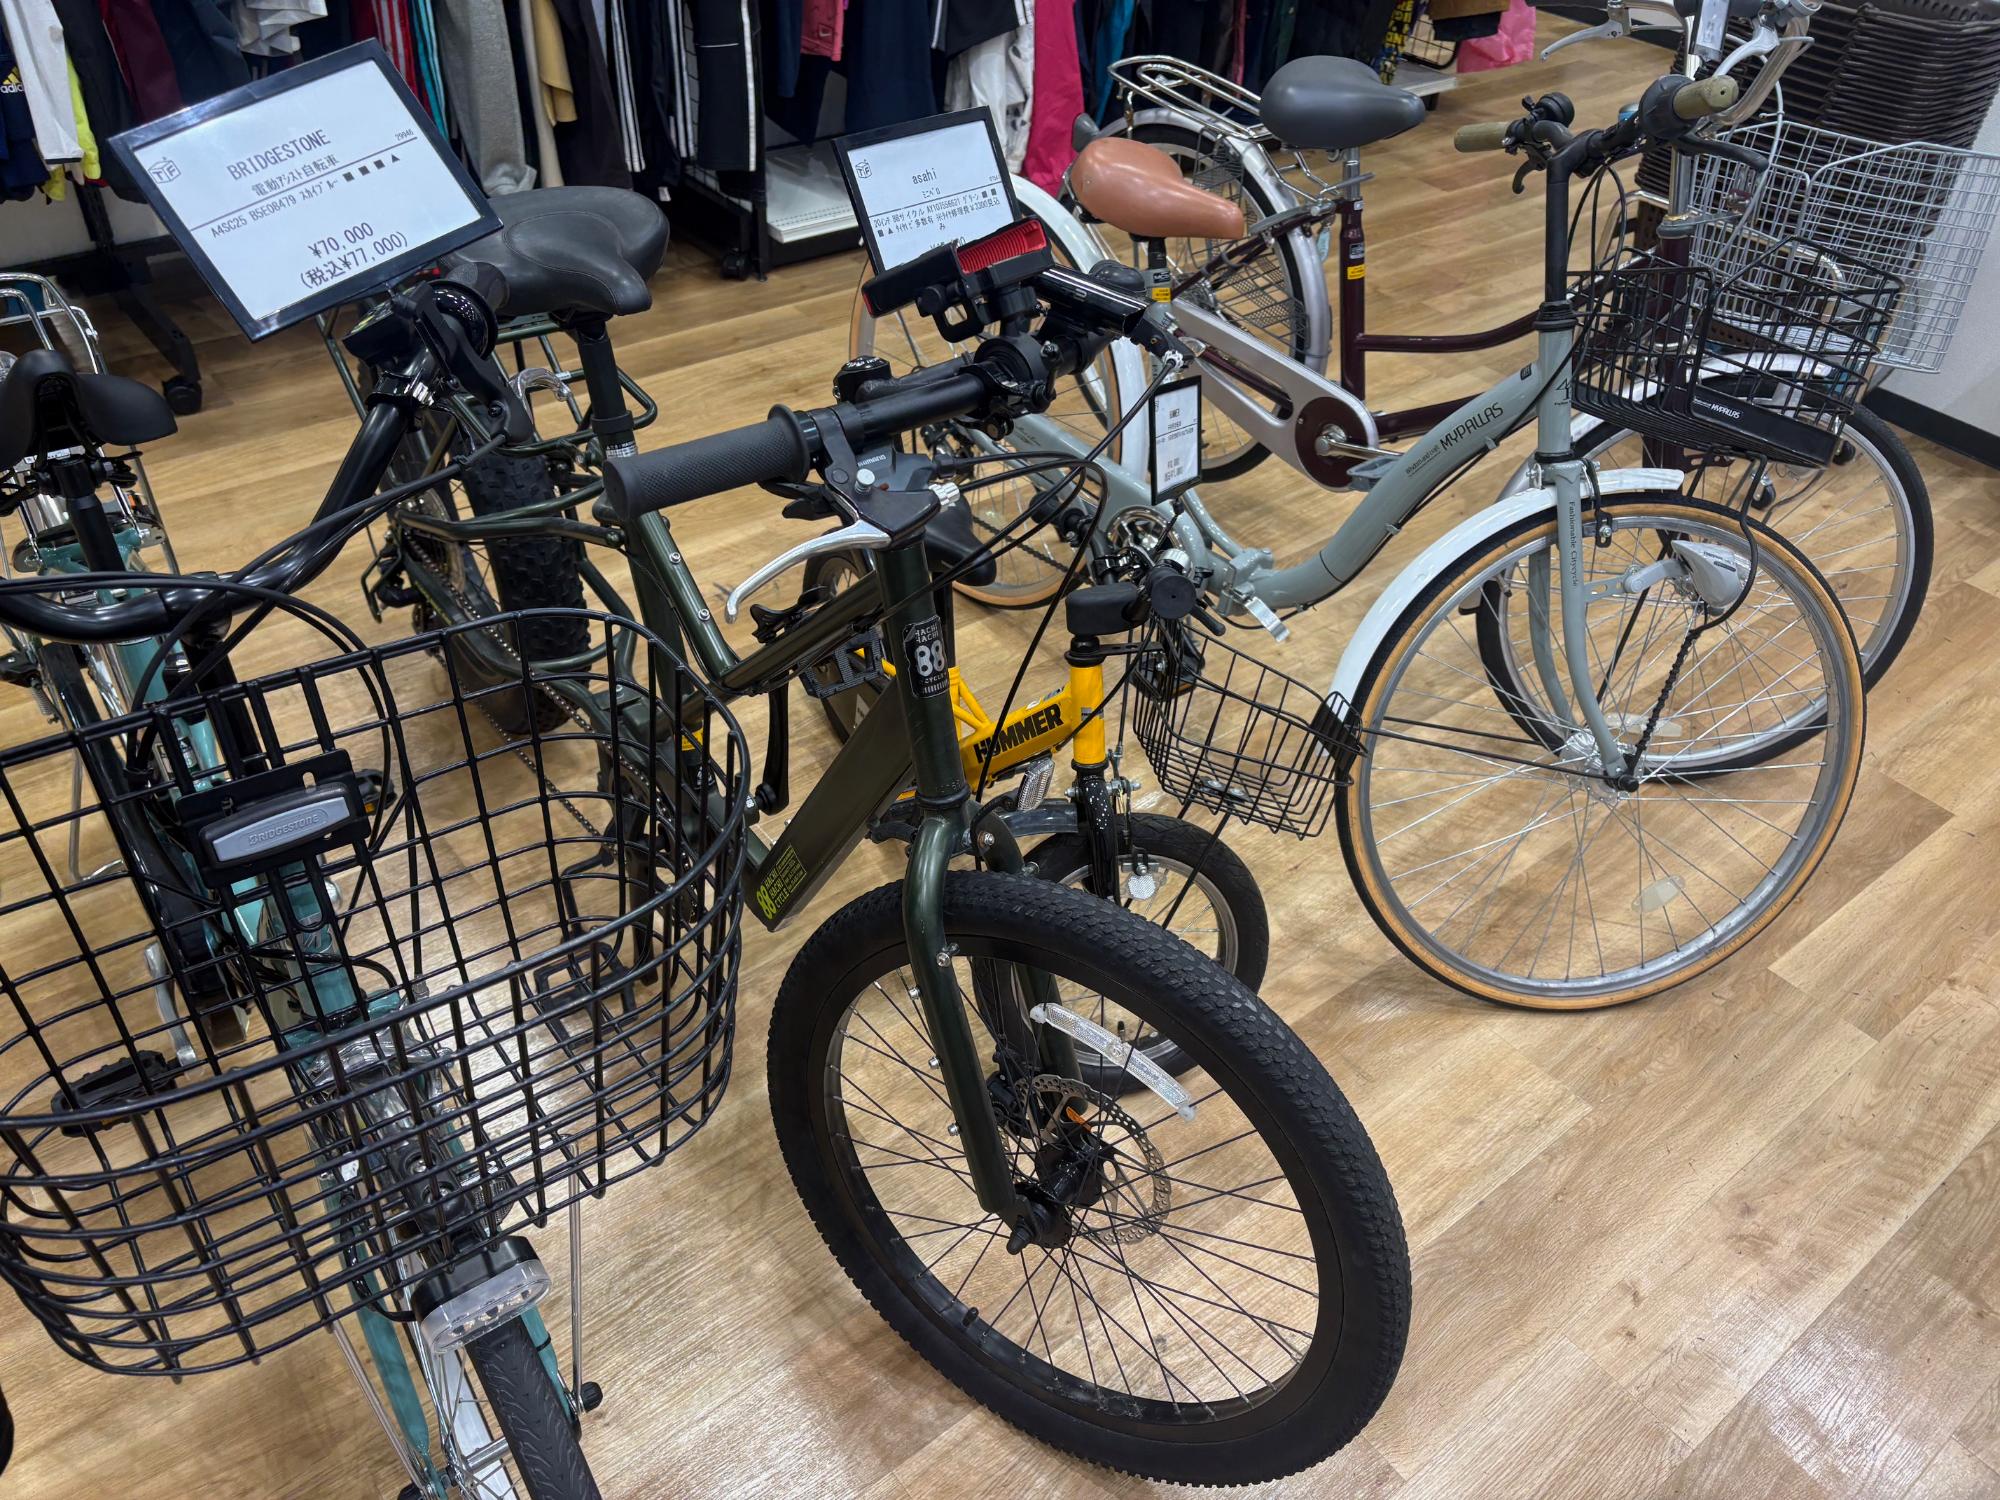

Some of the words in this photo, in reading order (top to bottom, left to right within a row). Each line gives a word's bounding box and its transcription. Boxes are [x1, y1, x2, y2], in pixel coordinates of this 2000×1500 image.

[226, 129, 331, 181] BRIDGESTONE
[912, 168, 937, 185] asahi
[211, 215, 247, 239] A4SC25
[308, 222, 374, 258] ¥70,000
[300, 231, 408, 289] (税込¥77,000)
[1440, 402, 1504, 451] MYPALLAS
[915, 640, 945, 677] 88
[973, 703, 1064, 764] HUMMER
[756, 885, 777, 919] 88
